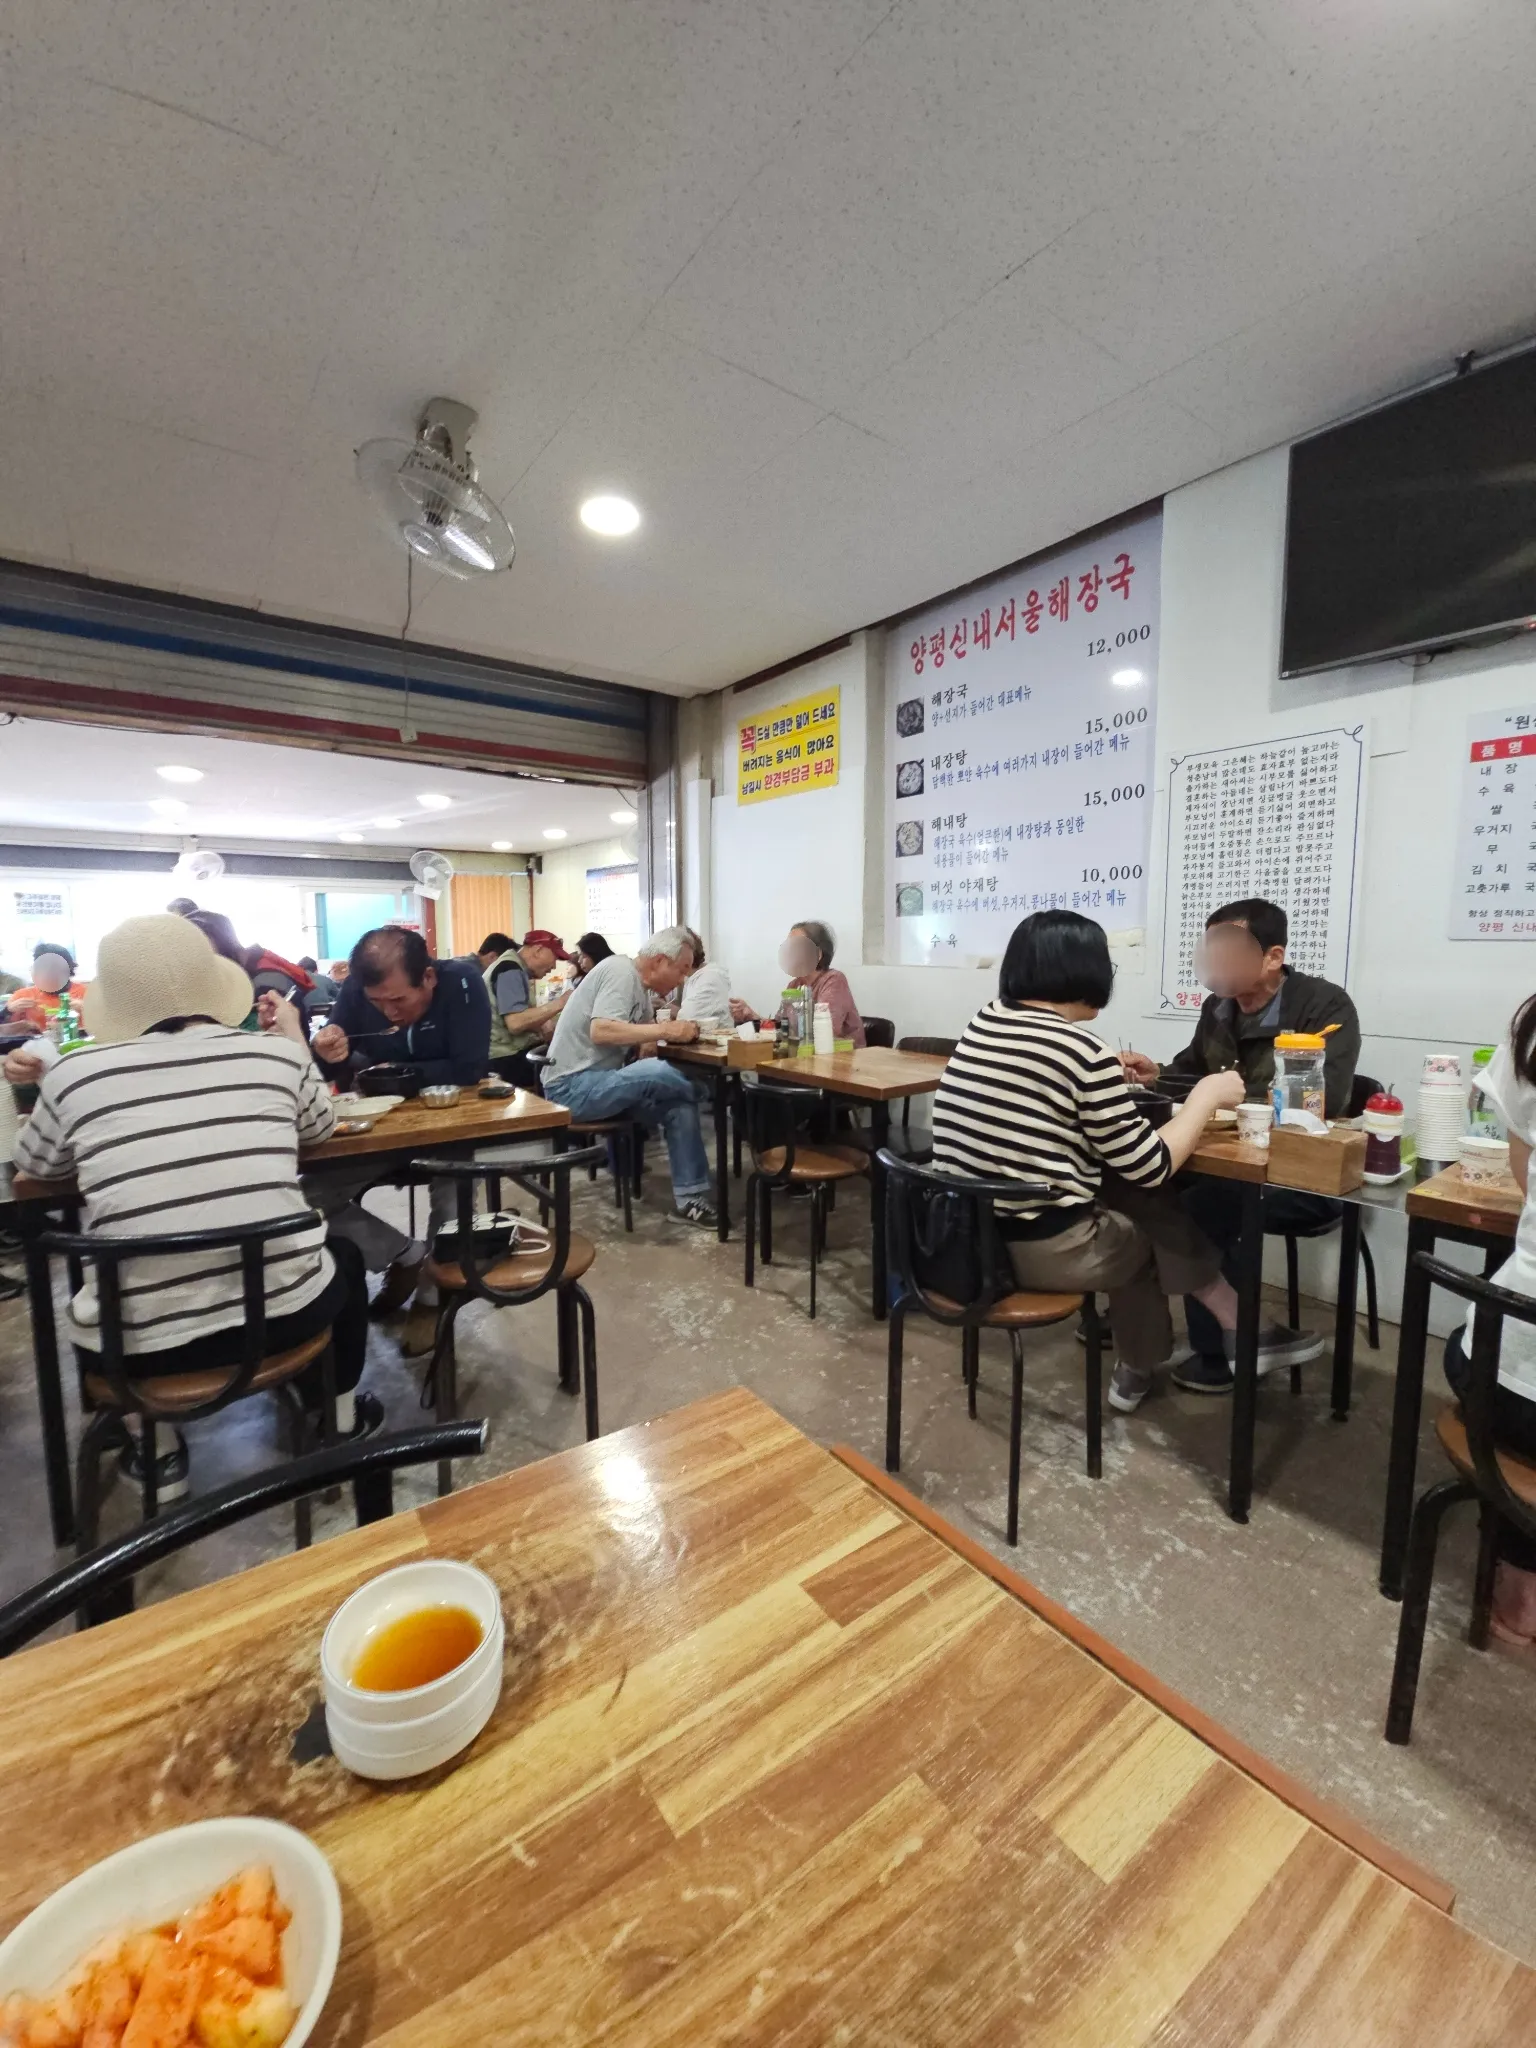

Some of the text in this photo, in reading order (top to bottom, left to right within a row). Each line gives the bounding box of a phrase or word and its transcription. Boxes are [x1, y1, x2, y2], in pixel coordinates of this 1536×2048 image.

[910, 553, 1136, 675] 양평신내서울해장국
[1086, 624, 1151, 657] 12,000
[931, 683, 969, 706] 해장국
[970, 694, 995, 716] 들어간
[741, 702, 835, 753] 꼭 드실 만큼만 덜어 드세요
[1085, 707, 1148, 735] 15,000
[742, 734, 834, 772] 버려지는 음식이 많아요
[931, 749, 968, 771] 내장탕
[932, 733, 1130, 790] 담백한 뽀얀 육수에 여러가지 내장이 들어간 메뉴
[742, 758, 835, 795] 남길시 환경부담금 부과
[1084, 783, 1145, 807] 15,000
[1490, 804, 1503, 815] 쌀
[931, 812, 968, 832] 해내탕
[933, 834, 955, 850] 해장국
[1016, 820, 1052, 841] 내장탕과
[1056, 815, 1085, 836] 동일한
[1473, 823, 1512, 836] 우거지
[966, 847, 990, 866] 들어간
[992, 846, 1009, 862] 메뉴
[1486, 844, 1498, 854] 무
[1081, 864, 1143, 884] 10,000
[930, 876, 999, 896] 버섯 야채탕
[1465, 883, 1510, 894] 고춧가루
[956, 897, 979, 913] 육수에
[1072, 889, 1101, 909] 들어간
[1106, 888, 1127, 907] 메뉴
[1468, 909, 1488, 918] 항상
[1479, 922, 1504, 933] 양평
